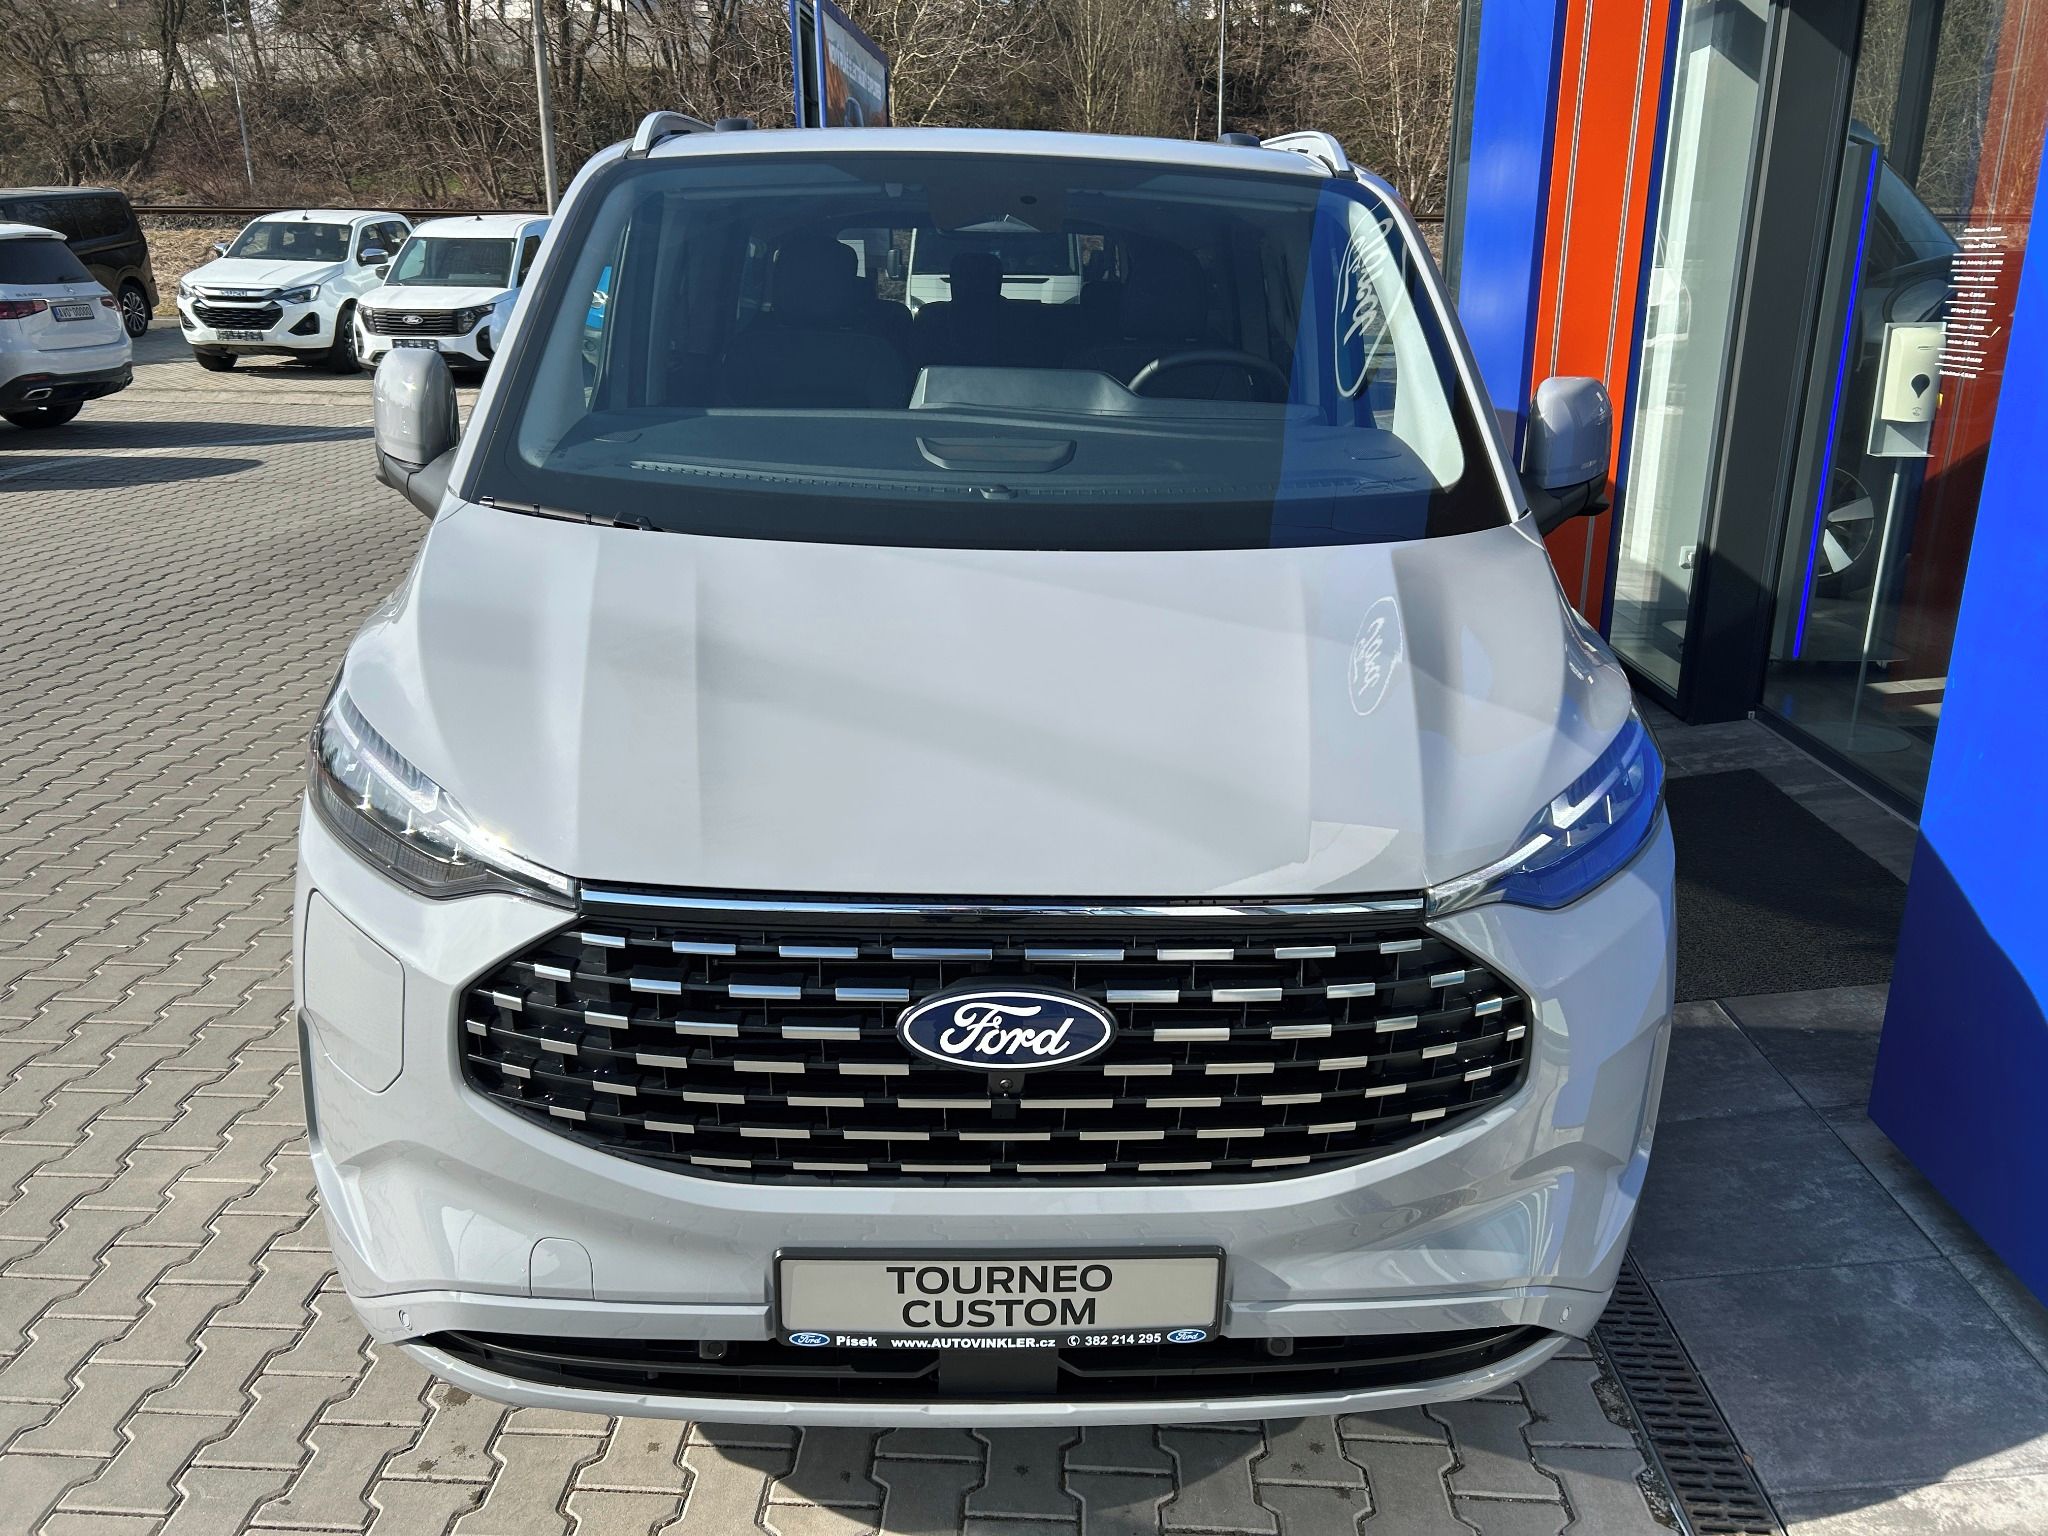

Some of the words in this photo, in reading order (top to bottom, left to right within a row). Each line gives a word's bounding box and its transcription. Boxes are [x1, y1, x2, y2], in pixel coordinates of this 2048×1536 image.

[939, 1002, 1075, 1056] Ford
[886, 1264, 1113, 1294] TOURNEO
[902, 1297, 1096, 1328] CUSTOM
[836, 1335, 878, 1347] Písek
[890, 1337, 1056, 1348] www.AUTOVINKLER.cz
[1085, 1335, 1108, 1346] 382
[1112, 1334, 1135, 1345] 214
[1138, 1333, 1161, 1344] 295
